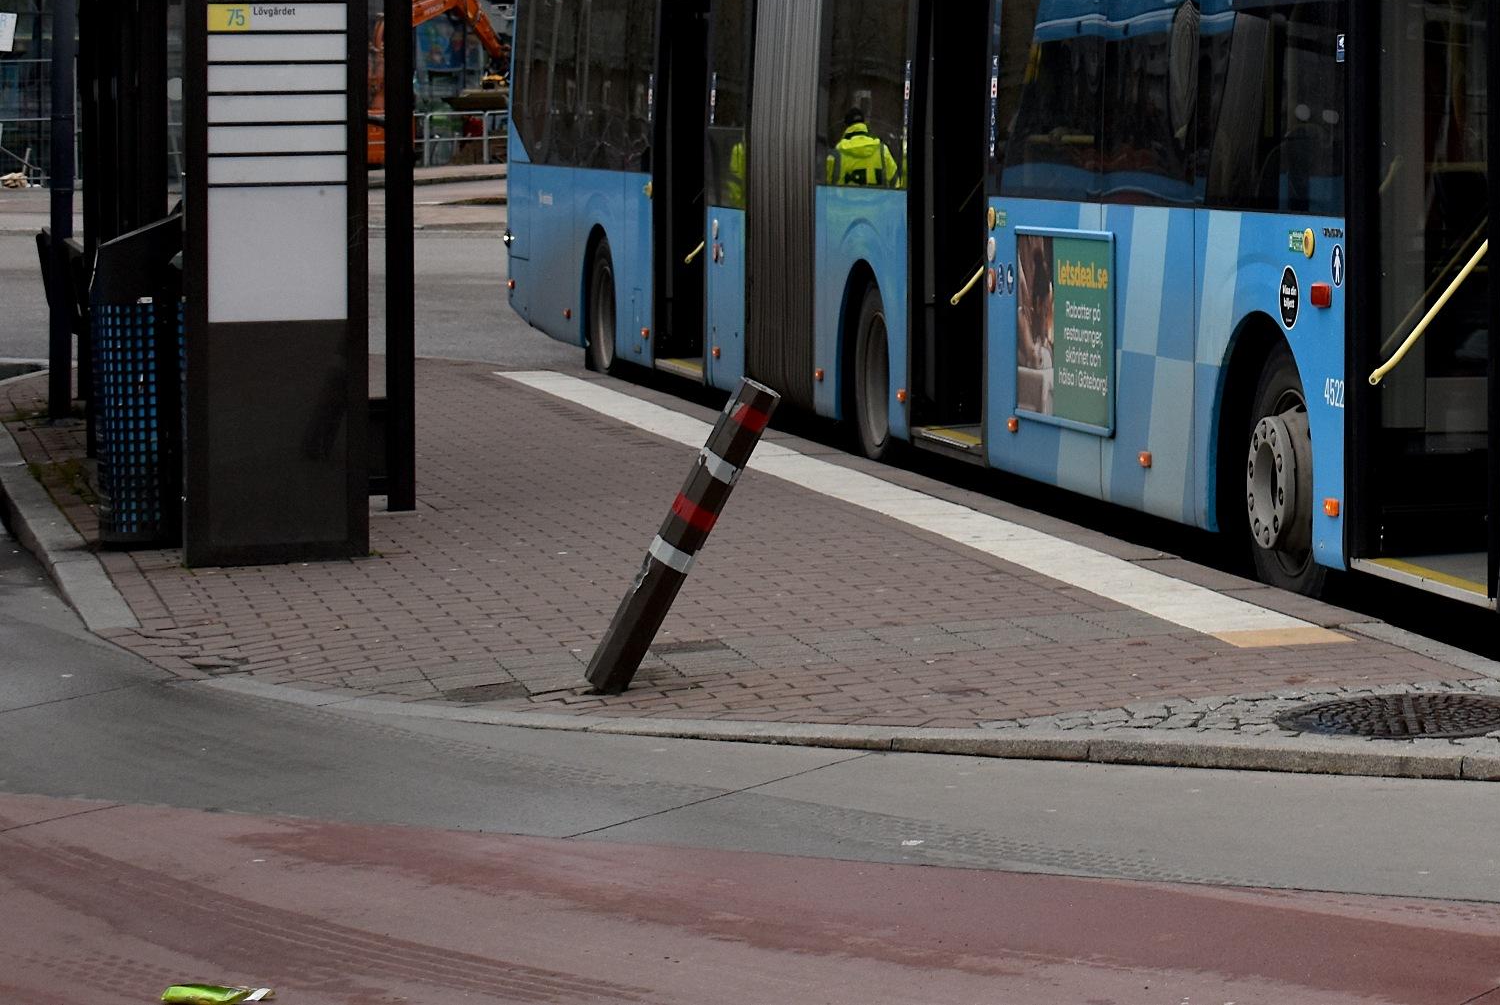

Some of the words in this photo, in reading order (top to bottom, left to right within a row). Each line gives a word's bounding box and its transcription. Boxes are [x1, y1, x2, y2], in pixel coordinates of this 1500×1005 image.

[226, 8, 245, 27] 75
[253, 6, 296, 19] Lövgärdet
[1058, 260, 1108, 289] letsdeal.se
[1092, 303, 1101, 325] på
[1065, 346, 1089, 366] skönhet
[1089, 352, 1101, 368] och
[1324, 377, 1344, 408] 4522
